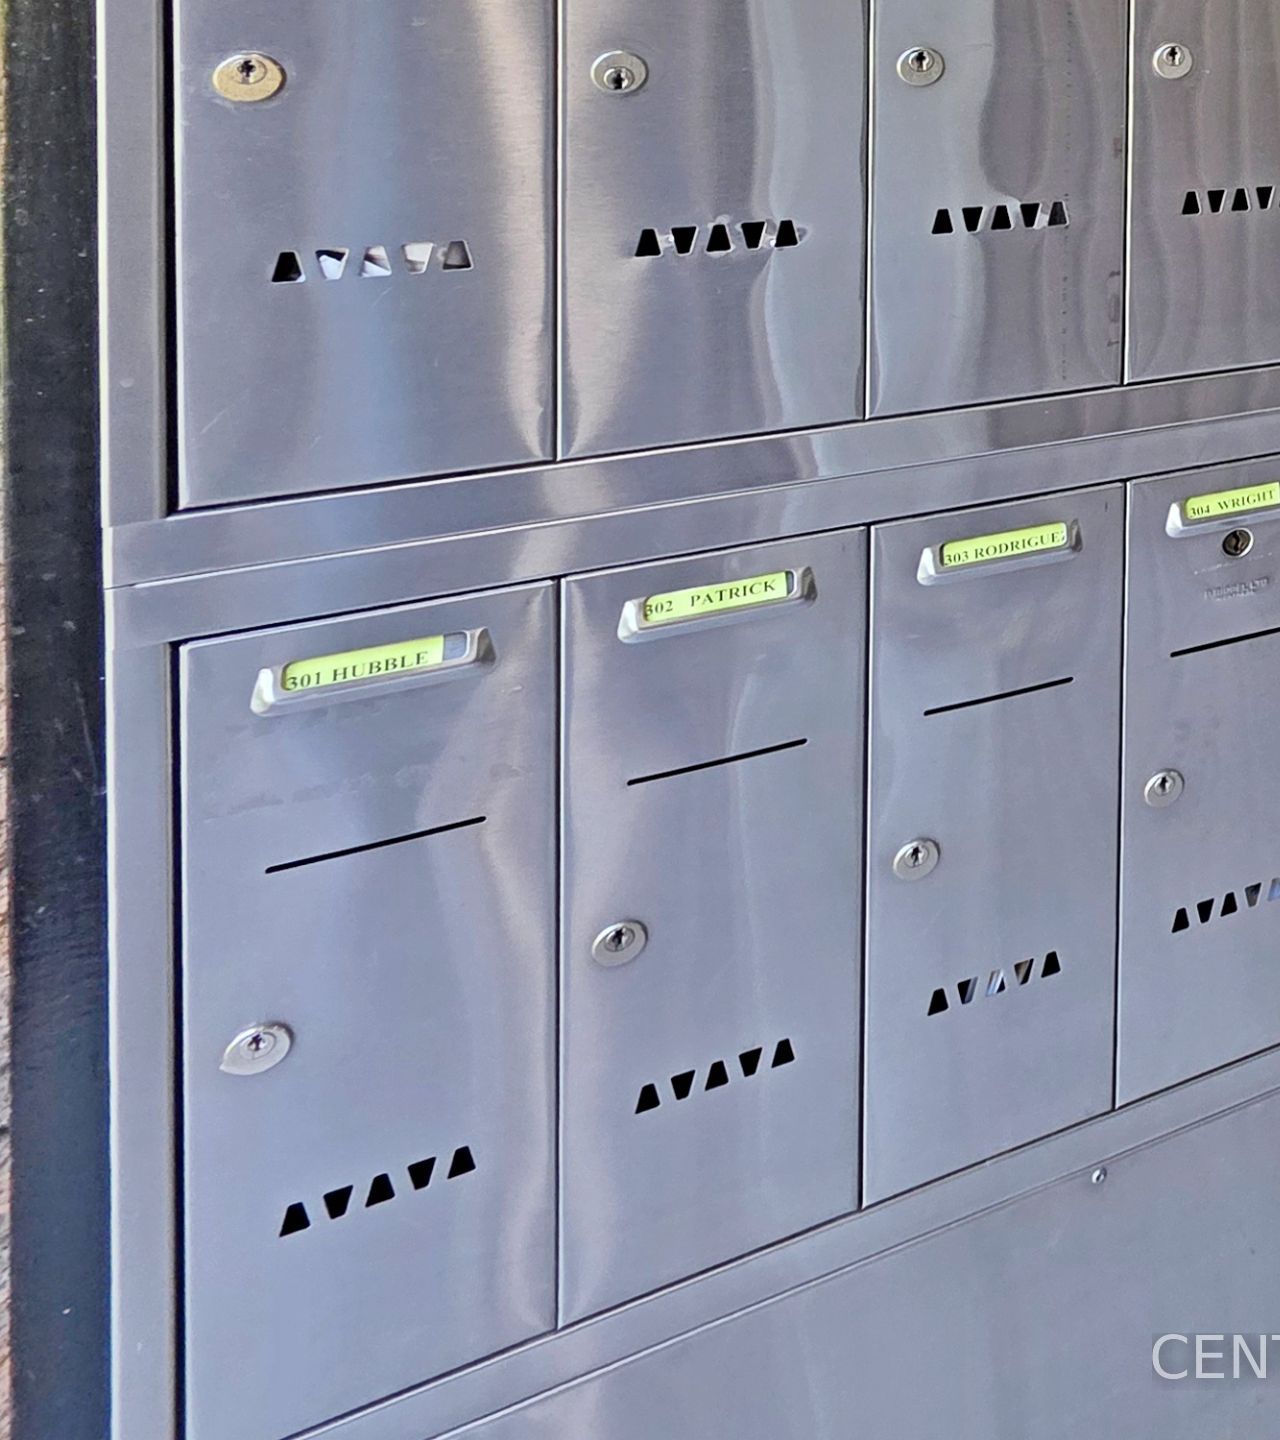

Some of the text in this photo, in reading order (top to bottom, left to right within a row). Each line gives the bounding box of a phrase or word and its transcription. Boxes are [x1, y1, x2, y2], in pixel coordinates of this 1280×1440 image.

[1189, 488, 1276, 518] 304 WRIGHT
[944, 550, 969, 566] 303
[644, 578, 777, 617] 302 PATRICK
[287, 650, 429, 691] 301 HUBBLE
